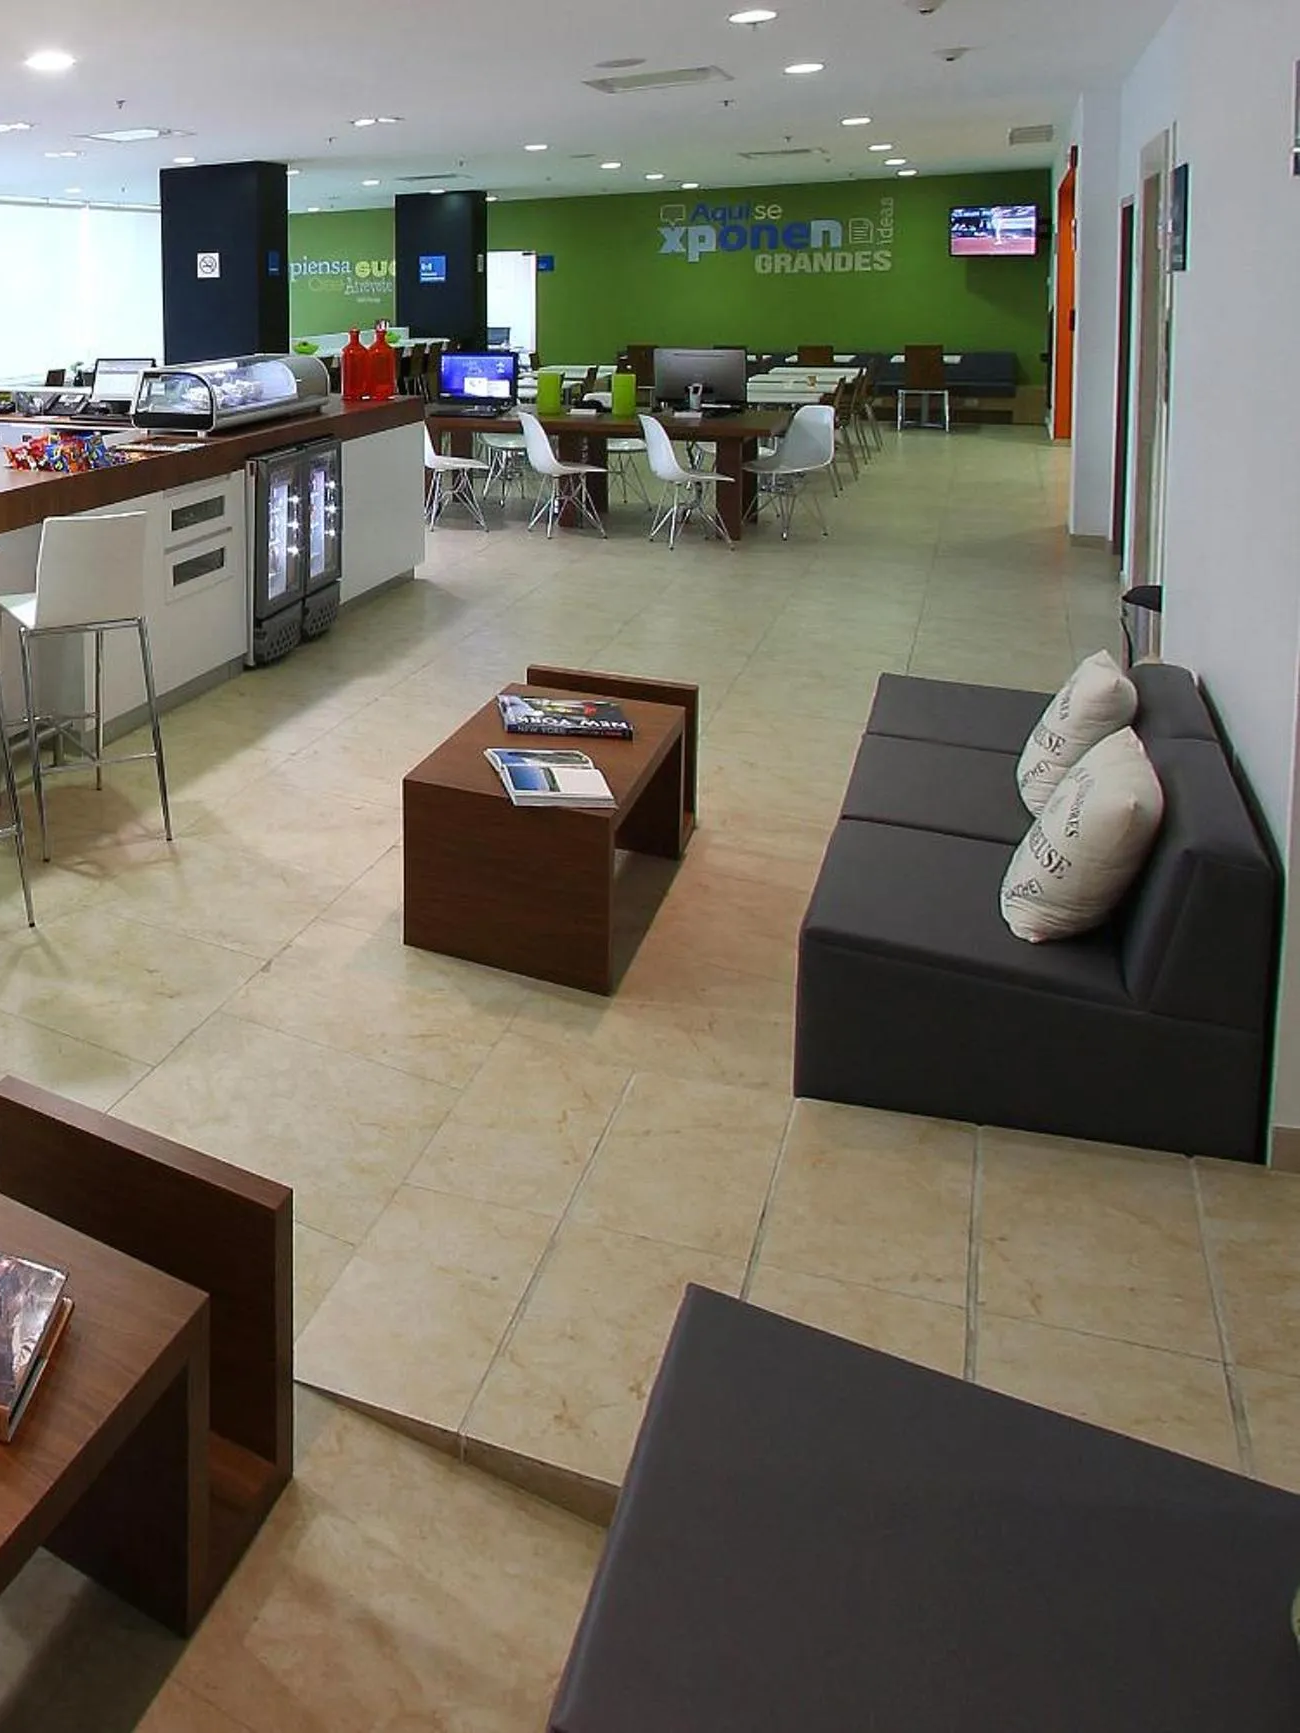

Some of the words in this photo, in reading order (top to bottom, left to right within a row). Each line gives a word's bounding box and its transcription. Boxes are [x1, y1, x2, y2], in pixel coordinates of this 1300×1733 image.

[754, 203, 783, 221] se
[658, 218, 844, 263] xponen
[290, 256, 352, 282] piensa
[755, 250, 892, 275] GRANDES
